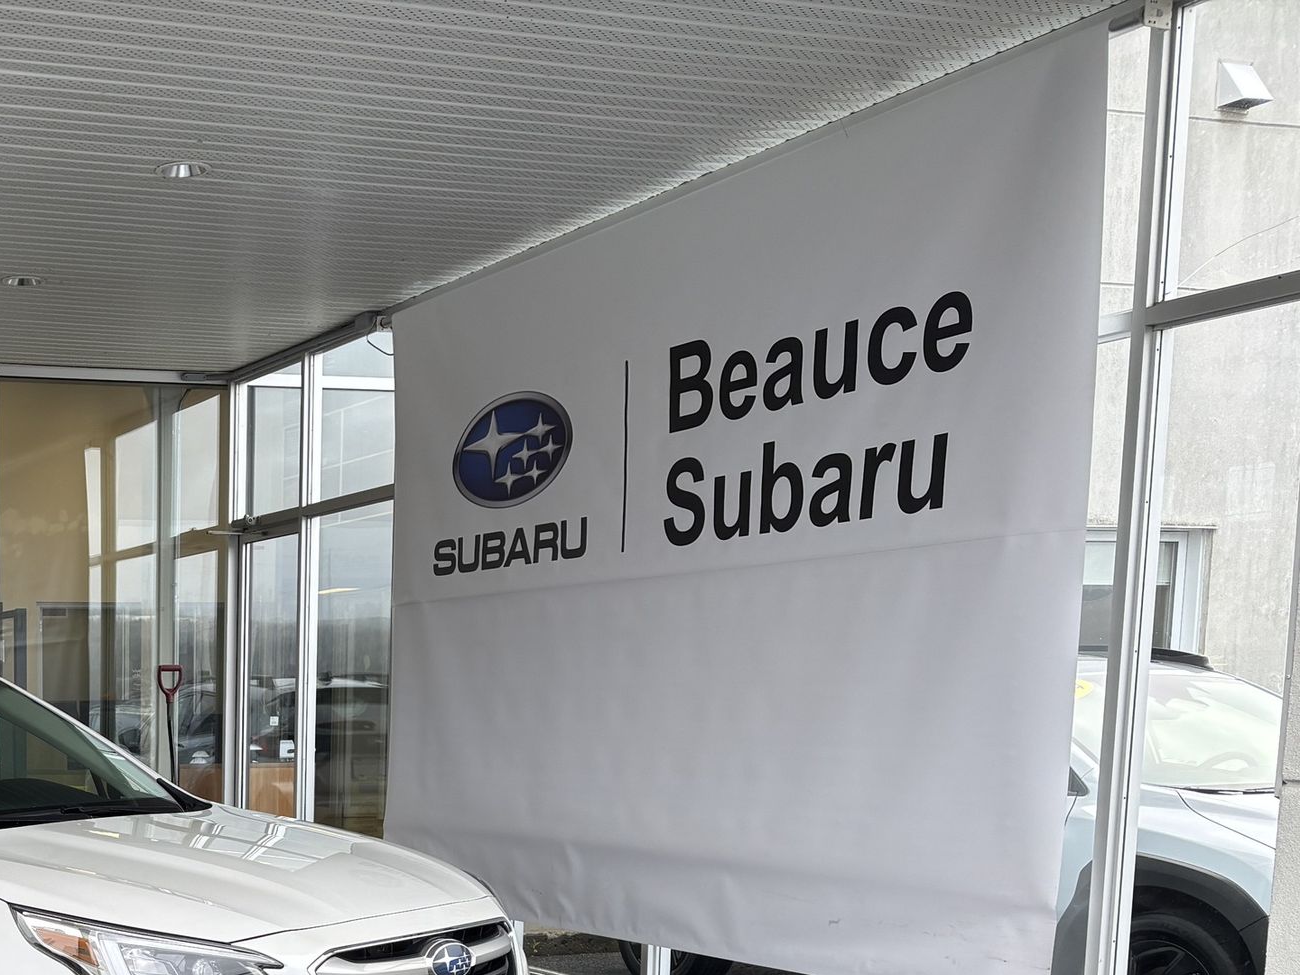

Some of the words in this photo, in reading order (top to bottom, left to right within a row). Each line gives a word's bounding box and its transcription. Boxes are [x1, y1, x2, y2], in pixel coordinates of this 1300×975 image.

[669, 291, 973, 433] Beauce
[433, 516, 588, 576] SUBARU
[663, 432, 949, 546] Subaru
